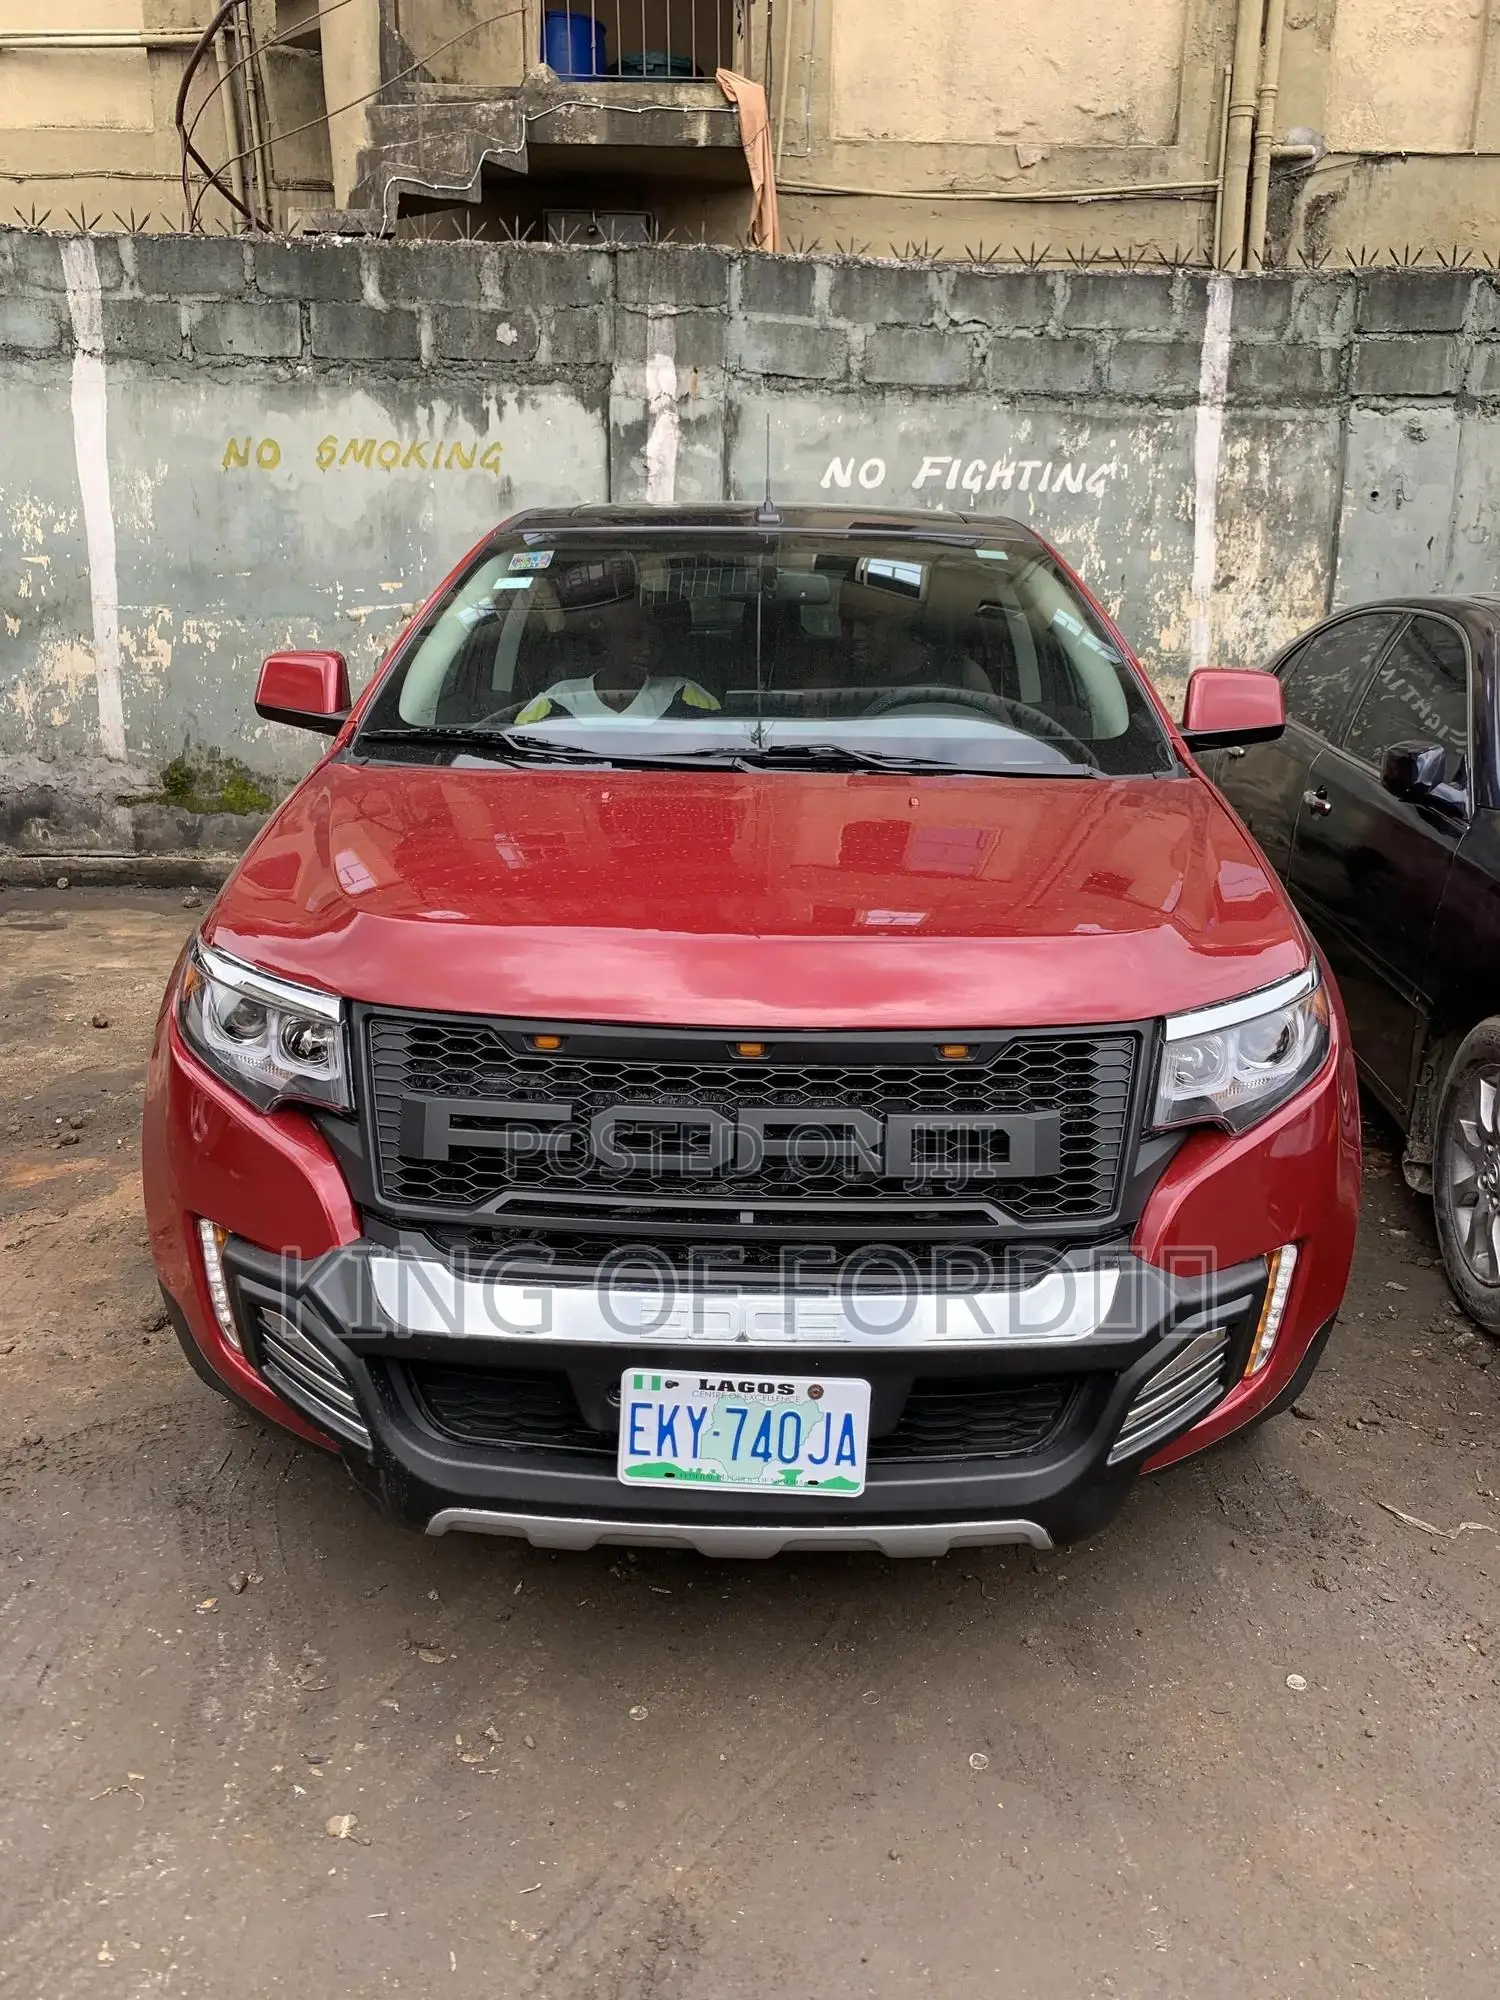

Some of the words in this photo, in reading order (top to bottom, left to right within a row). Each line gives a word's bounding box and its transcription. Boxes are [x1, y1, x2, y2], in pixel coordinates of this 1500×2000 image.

[222, 436, 281, 472] NO
[316, 435, 503, 475] SMOKING
[820, 457, 886, 489] NO
[911, 456, 1113, 498] FIGHTING
[396, 1093, 1061, 1178] FORD
[691, 1389, 728, 1400] CENTRE
[699, 1378, 795, 1396] LAGOS
